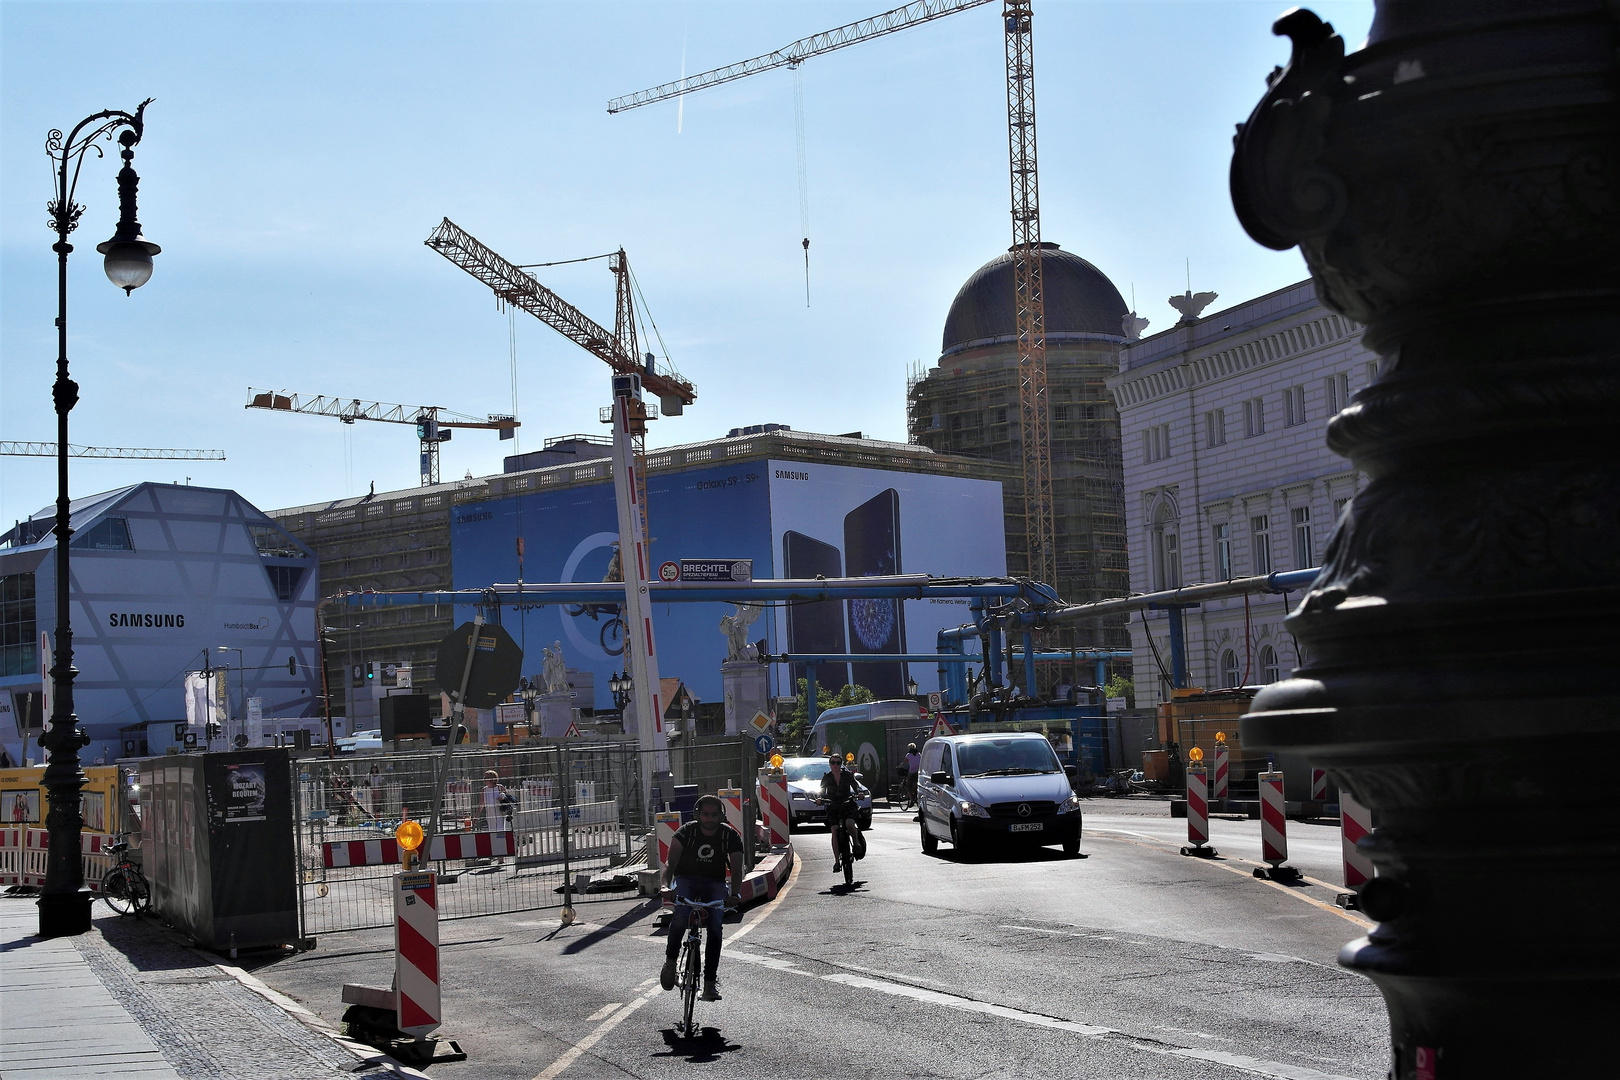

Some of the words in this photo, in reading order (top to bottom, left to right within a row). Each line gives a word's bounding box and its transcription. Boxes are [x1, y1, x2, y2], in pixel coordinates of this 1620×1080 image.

[775, 470, 809, 482] SAMSUNG
[696, 479, 727, 490] Galaxy
[727, 476, 738, 487] S9
[456, 511, 493, 525] SAMSUNG
[682, 564, 730, 573] BRECHTEL
[109, 613, 185, 628] SAMSUNG
[232, 781, 256, 789] MOZART
[232, 789, 258, 798] REQUIEM
